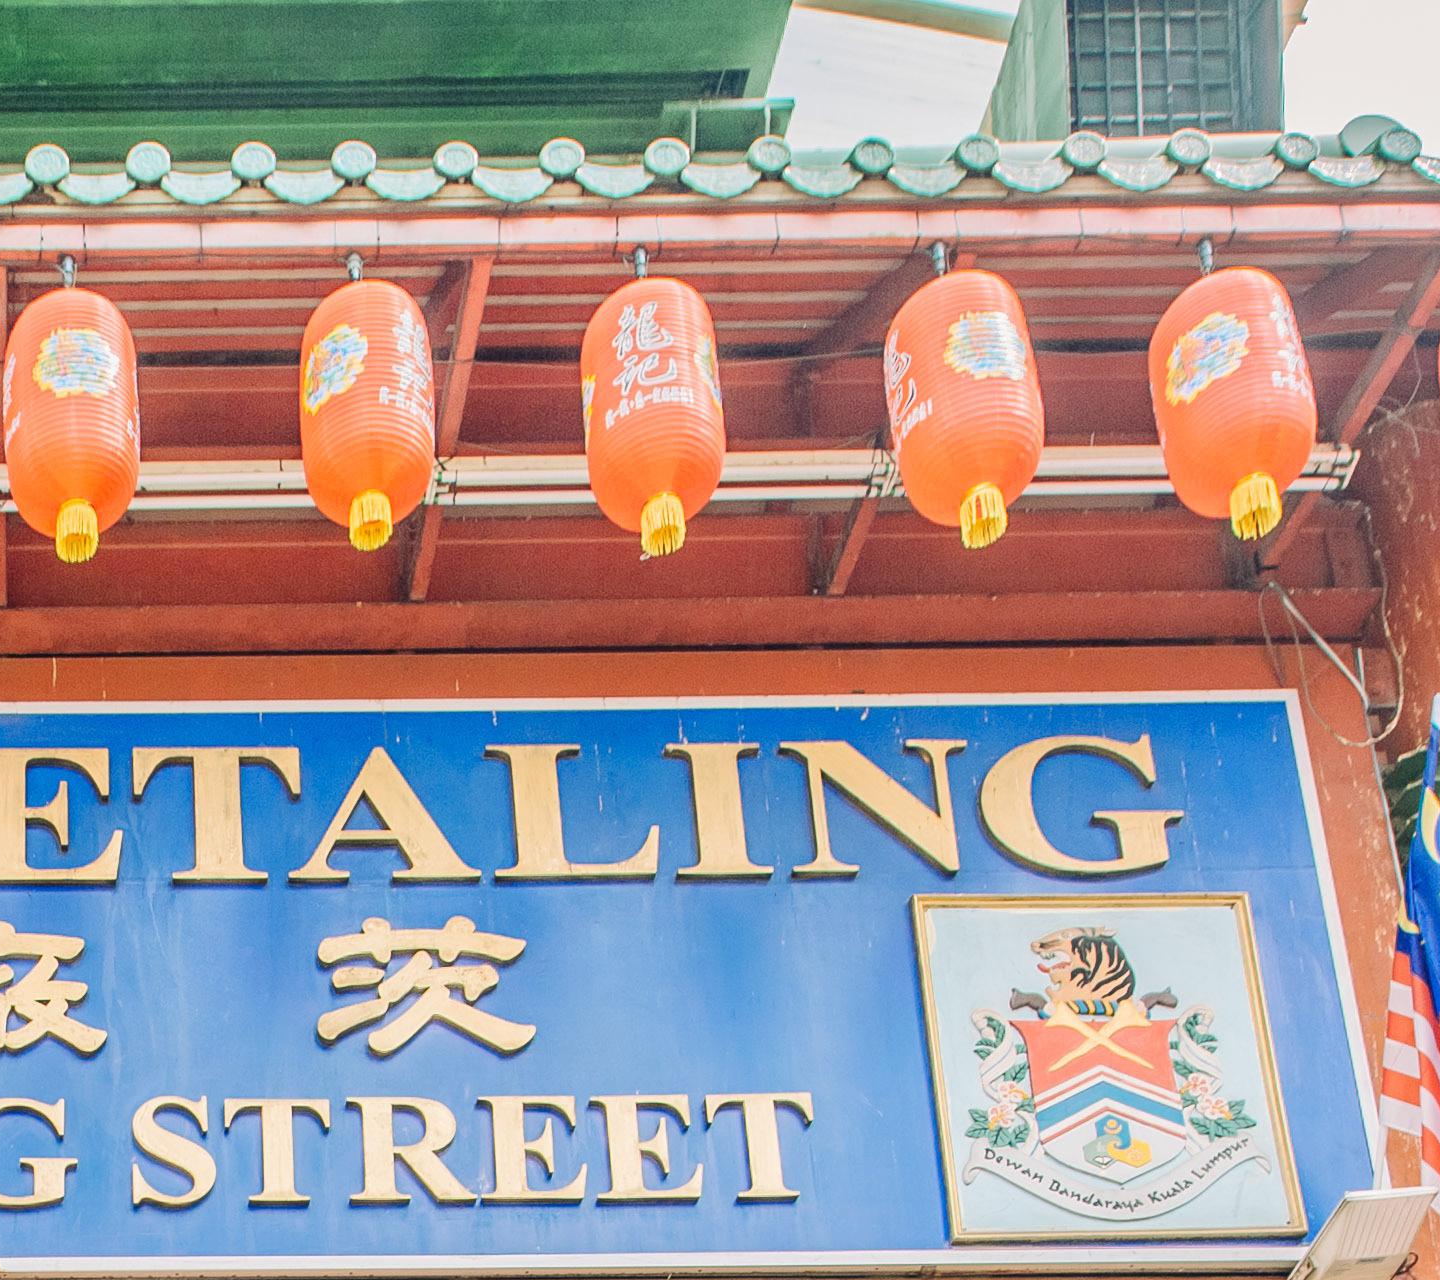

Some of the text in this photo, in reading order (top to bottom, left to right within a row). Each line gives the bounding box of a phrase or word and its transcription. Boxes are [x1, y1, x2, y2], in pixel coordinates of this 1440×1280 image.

[131, 1090, 816, 1210] STREET
[983, 1134, 1250, 1213] Dewan Bandaraya Kuala Lumpur
